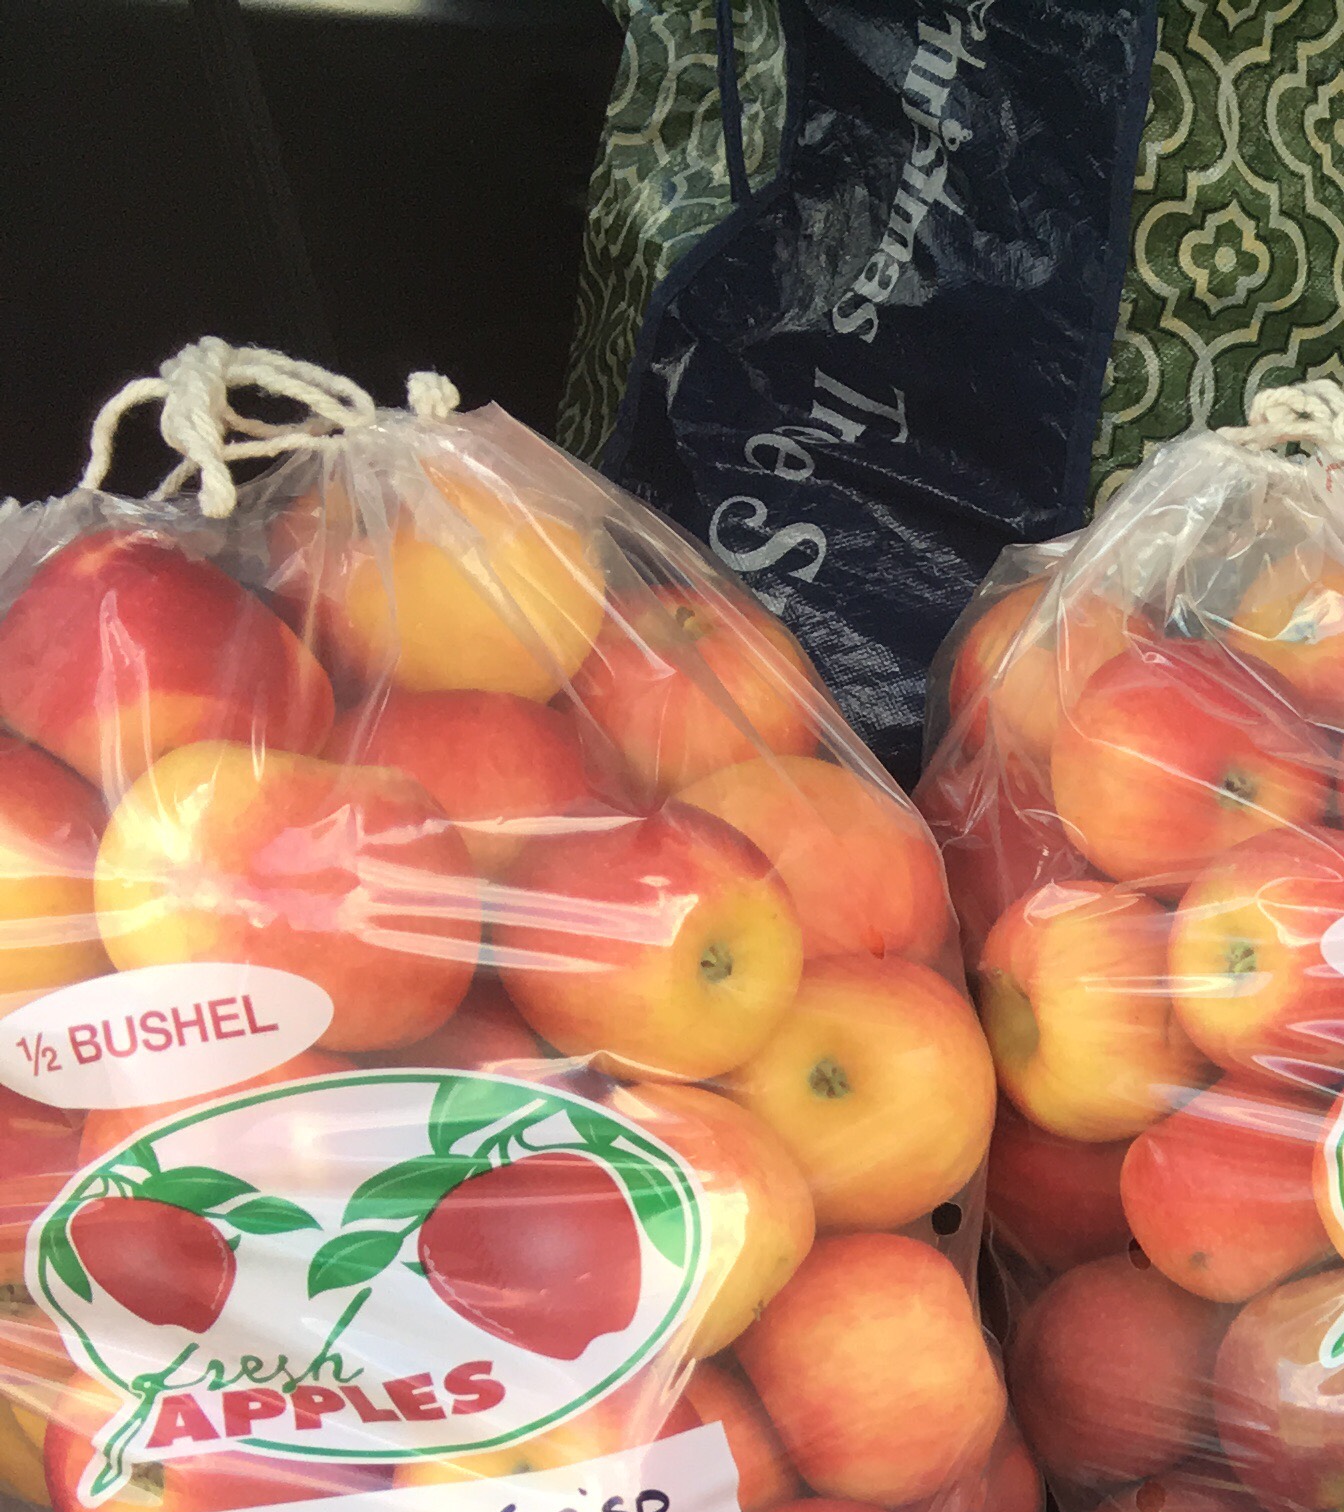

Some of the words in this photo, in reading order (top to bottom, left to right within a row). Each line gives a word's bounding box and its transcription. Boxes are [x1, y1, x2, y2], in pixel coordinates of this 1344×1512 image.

[832, 0, 994, 343] hristmas
[68, 995, 279, 1065] BUSHEL
[146, 1361, 506, 1448] APPLES
